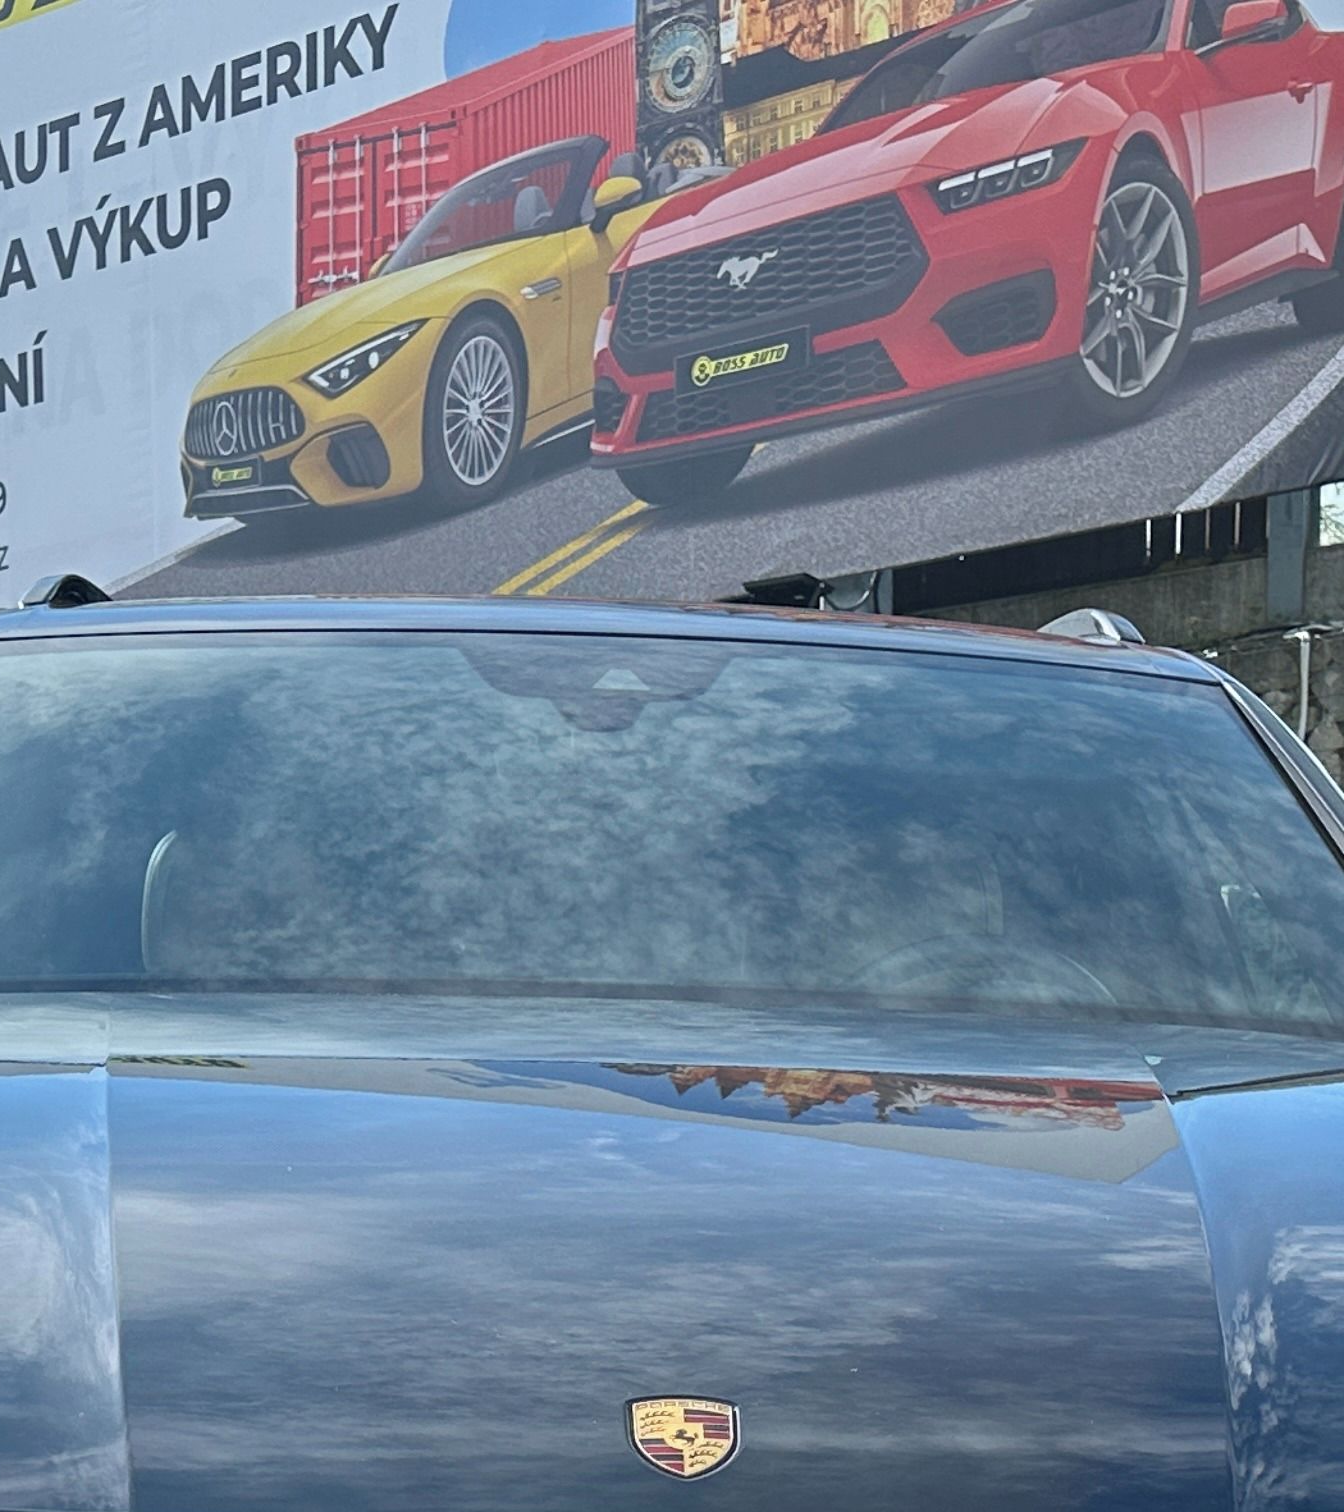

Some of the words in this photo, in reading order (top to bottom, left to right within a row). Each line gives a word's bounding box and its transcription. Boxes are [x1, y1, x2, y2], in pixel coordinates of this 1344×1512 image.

[92, 97, 127, 163] Z
[137, 2, 400, 149] AMERIKY
[46, 176, 232, 281] VÝKUP
[712, 355, 747, 374] BOSS
[749, 346, 785, 367] AUTO
